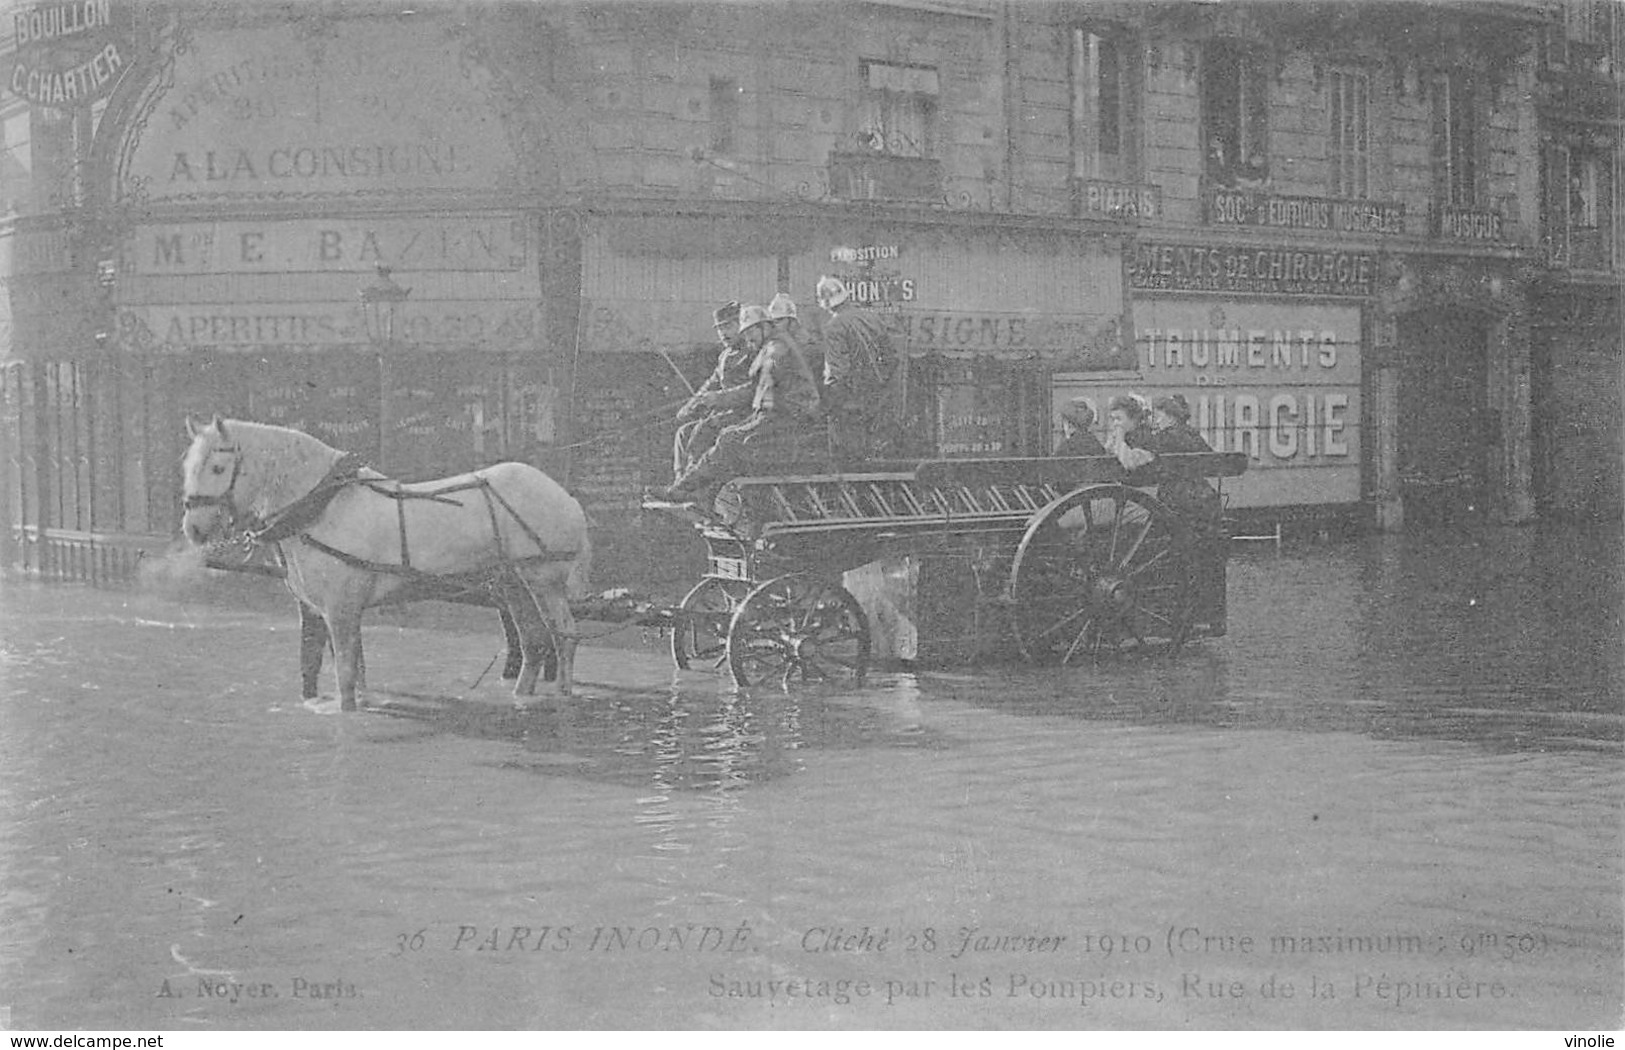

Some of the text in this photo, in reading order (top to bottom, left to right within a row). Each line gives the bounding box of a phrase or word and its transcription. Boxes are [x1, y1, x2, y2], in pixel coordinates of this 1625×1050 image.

[16, 0, 110, 44] BOUILLON
[206, 150, 258, 181] LA
[268, 145, 471, 178] CONSIGNE
[1441, 211, 1500, 239] MUSIQUE
[1225, 255, 1249, 277] DE
[1255, 250, 1370, 283] CHIRURGIE
[846, 279, 914, 302] HONY'S
[1144, 328, 1338, 369] TRUMENTS
